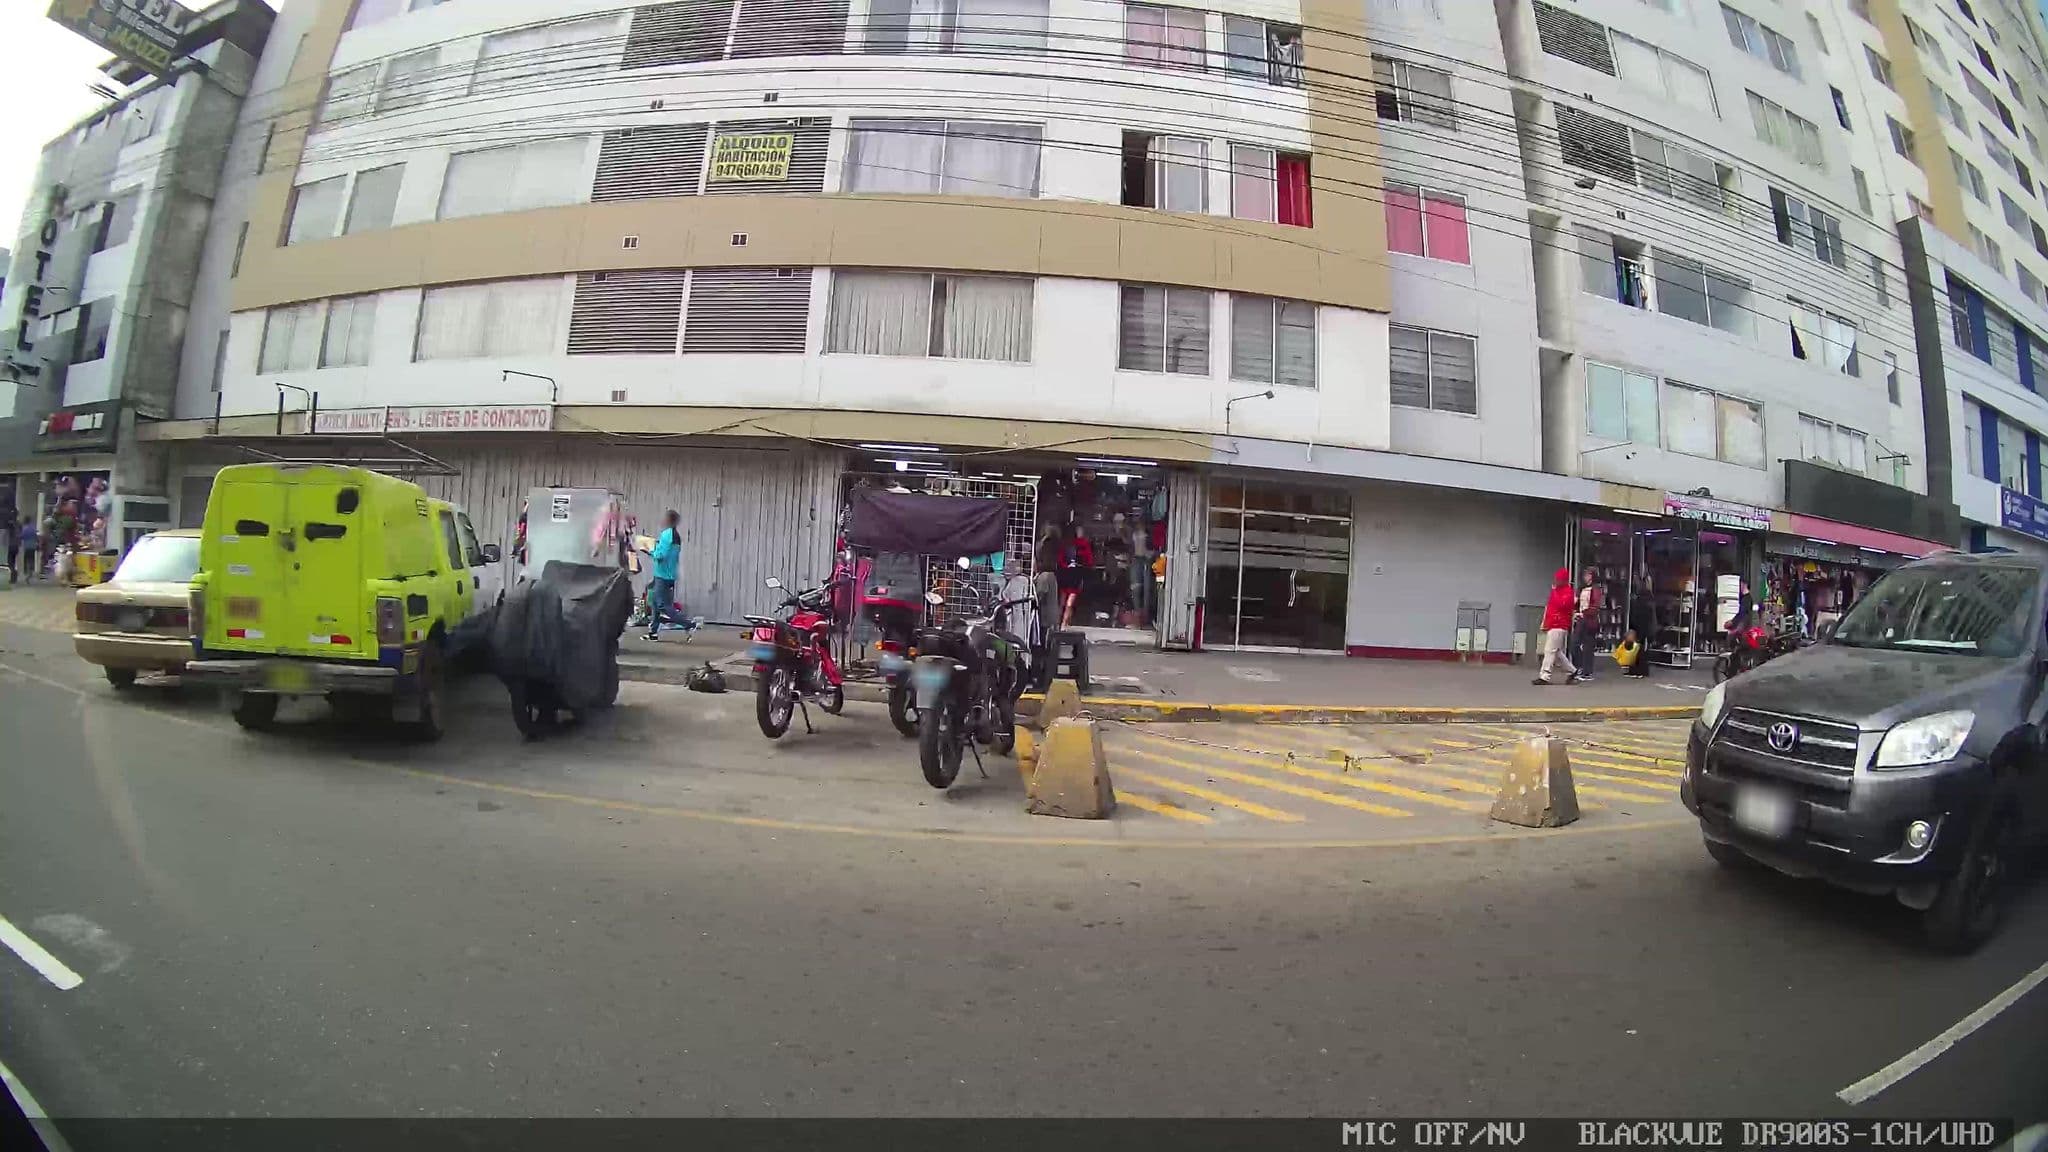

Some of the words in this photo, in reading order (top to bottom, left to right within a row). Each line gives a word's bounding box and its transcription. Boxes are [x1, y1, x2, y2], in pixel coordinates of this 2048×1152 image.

[718, 136, 788, 149] ALQUILO
[716, 150, 786, 162] HABITACION
[419, 410, 460, 428] LENTES
[463, 409, 479, 428] DE
[482, 407, 547, 428] CONTACTO
